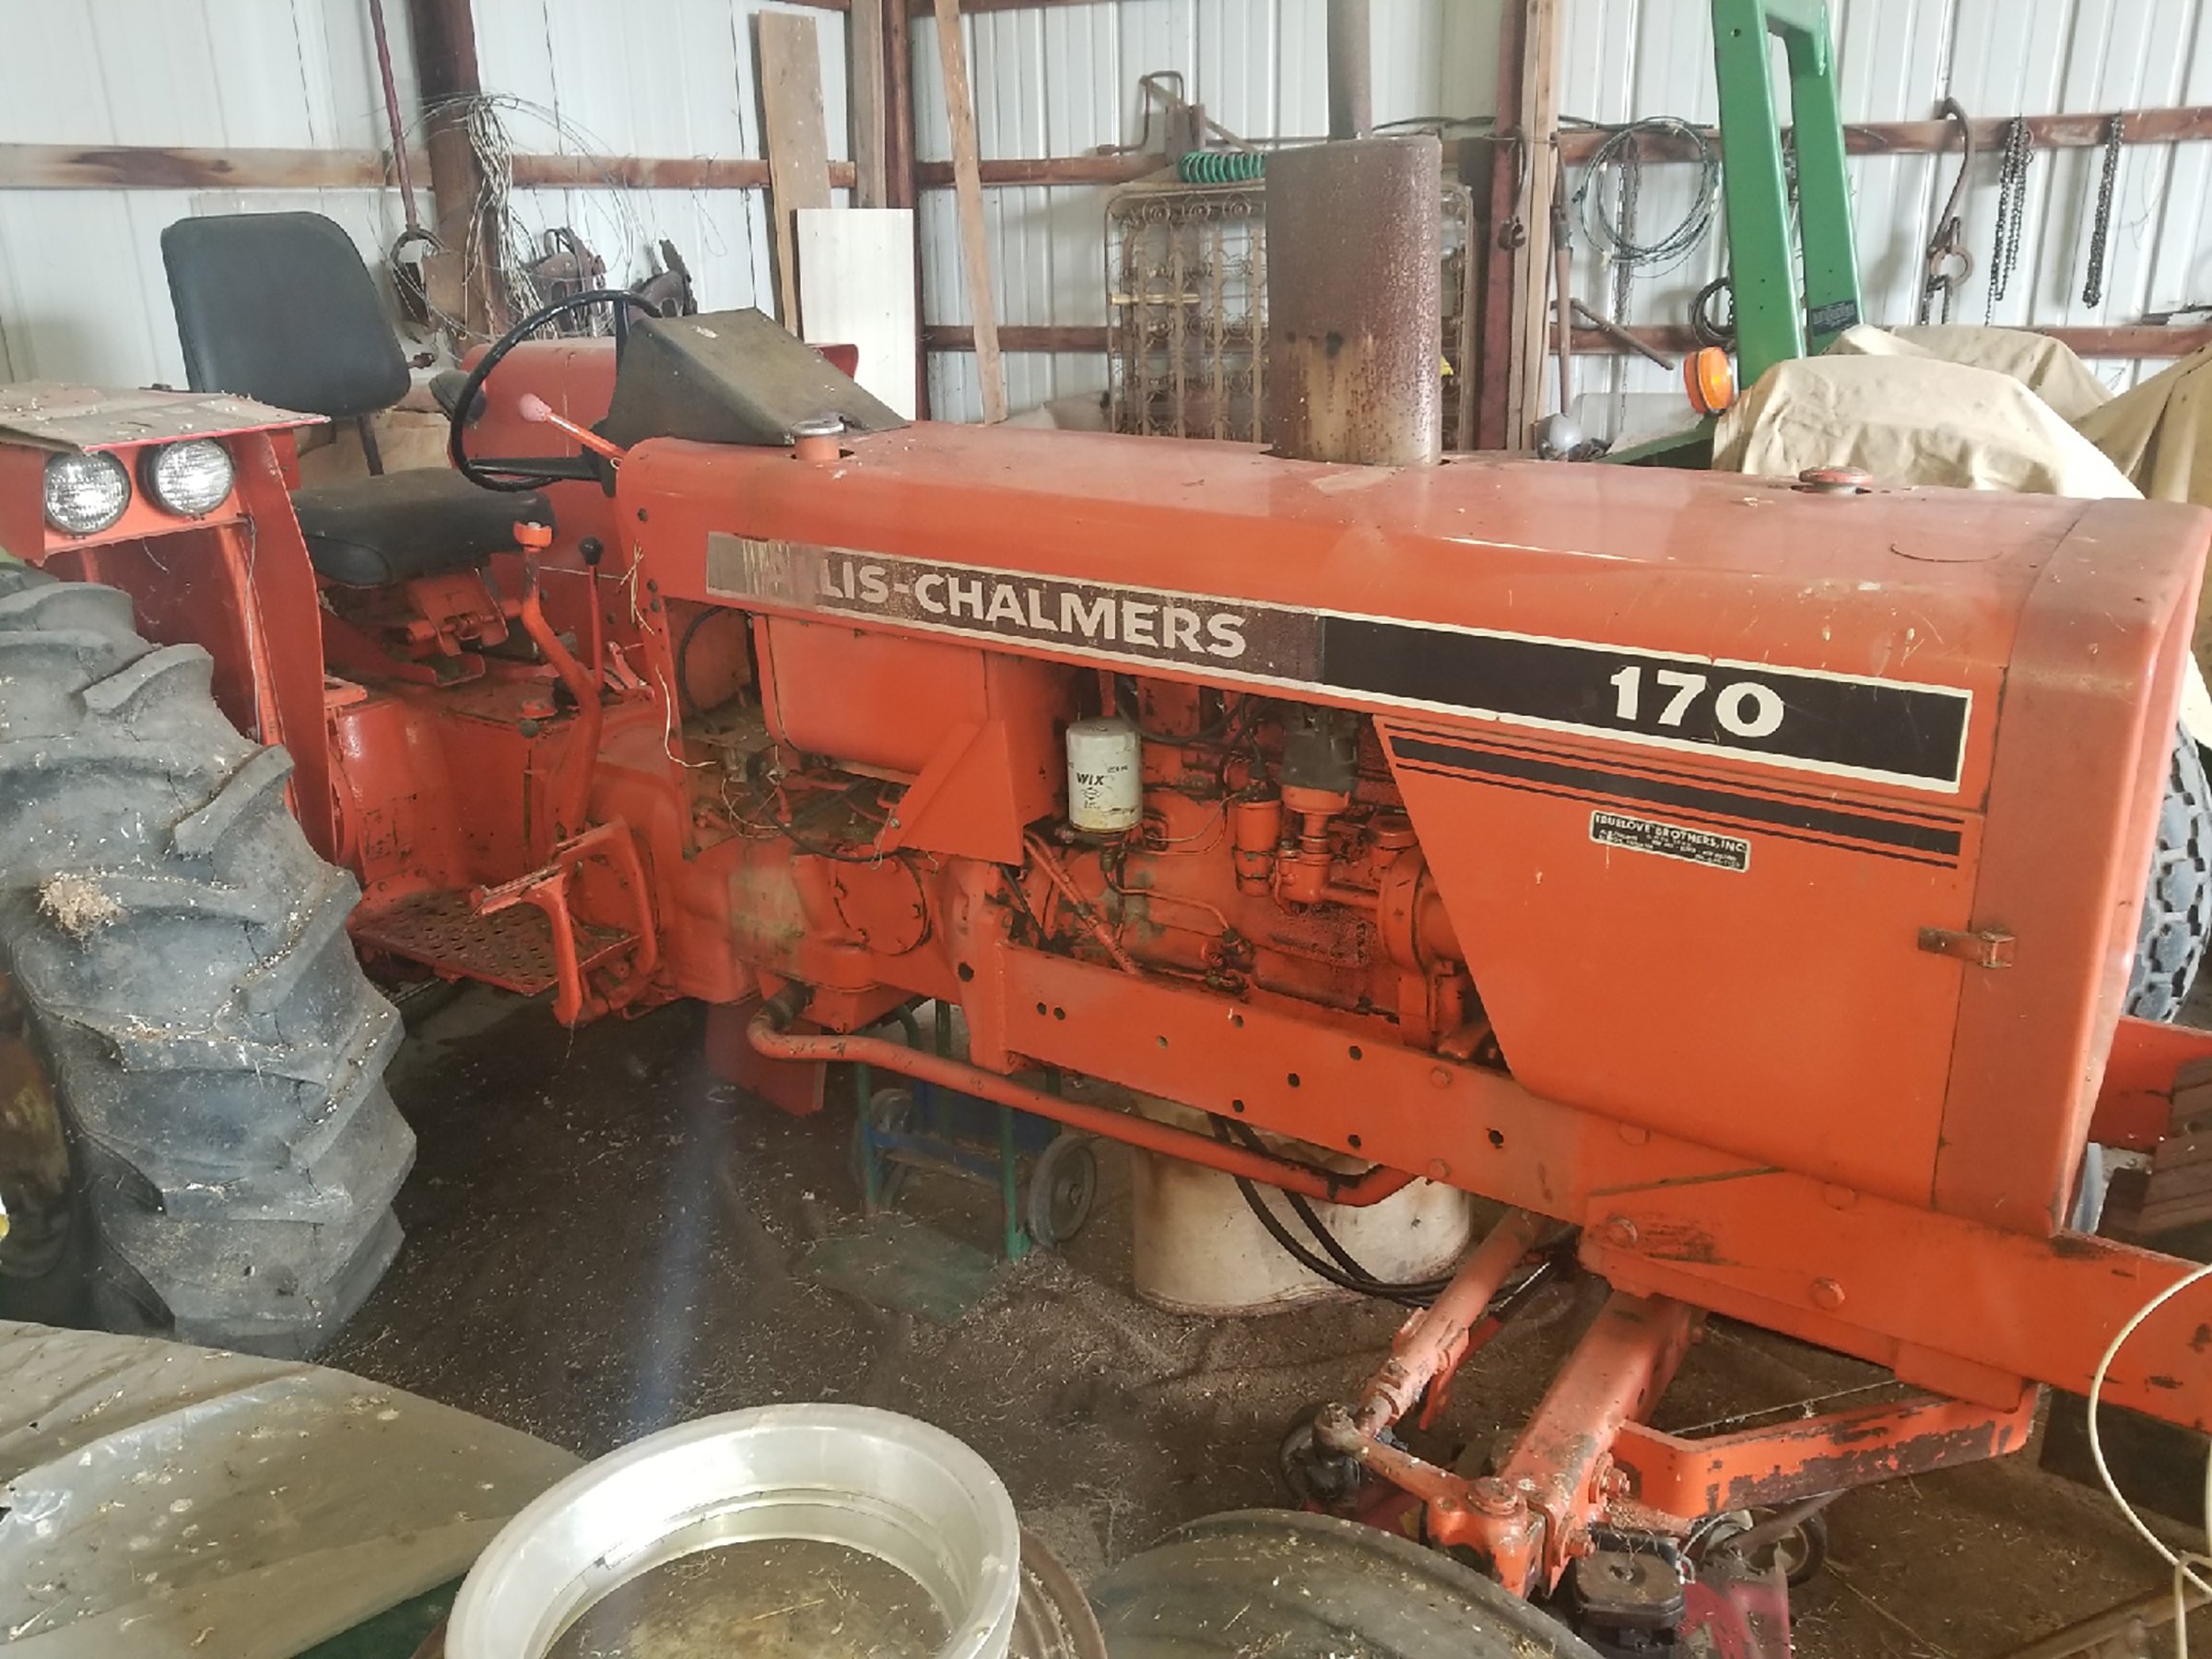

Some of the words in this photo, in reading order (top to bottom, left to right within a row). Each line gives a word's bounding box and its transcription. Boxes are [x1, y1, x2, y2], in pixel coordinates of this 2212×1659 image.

[763, 551, 1246, 659] LIS-CHALMERS
[1610, 665, 1784, 737] 170
[1077, 772, 1105, 785] WIX
[1595, 814, 1651, 833] TRUELOVE
